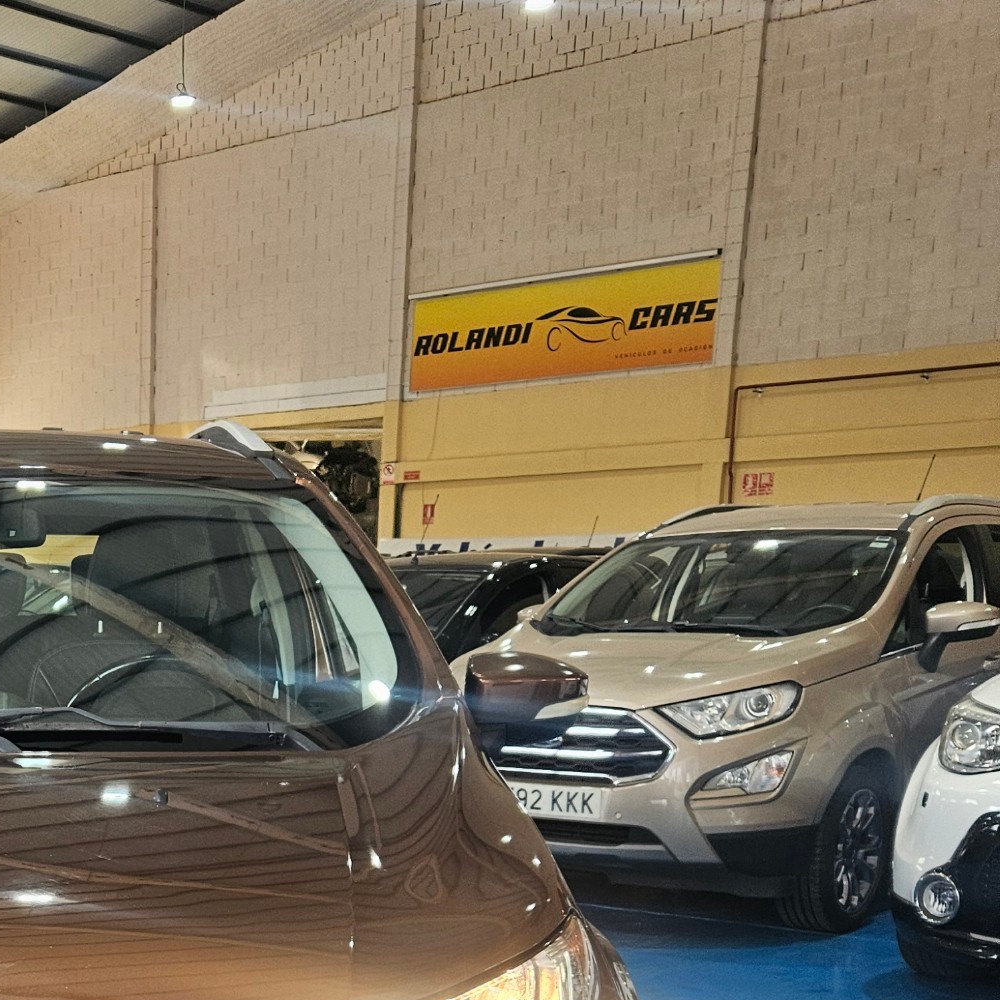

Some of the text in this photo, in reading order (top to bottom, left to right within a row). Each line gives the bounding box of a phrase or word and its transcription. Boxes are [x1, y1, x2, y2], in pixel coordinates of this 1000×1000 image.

[413, 298, 719, 357] ROLANDI CARS
[510, 786, 595, 815] 92 KKK
